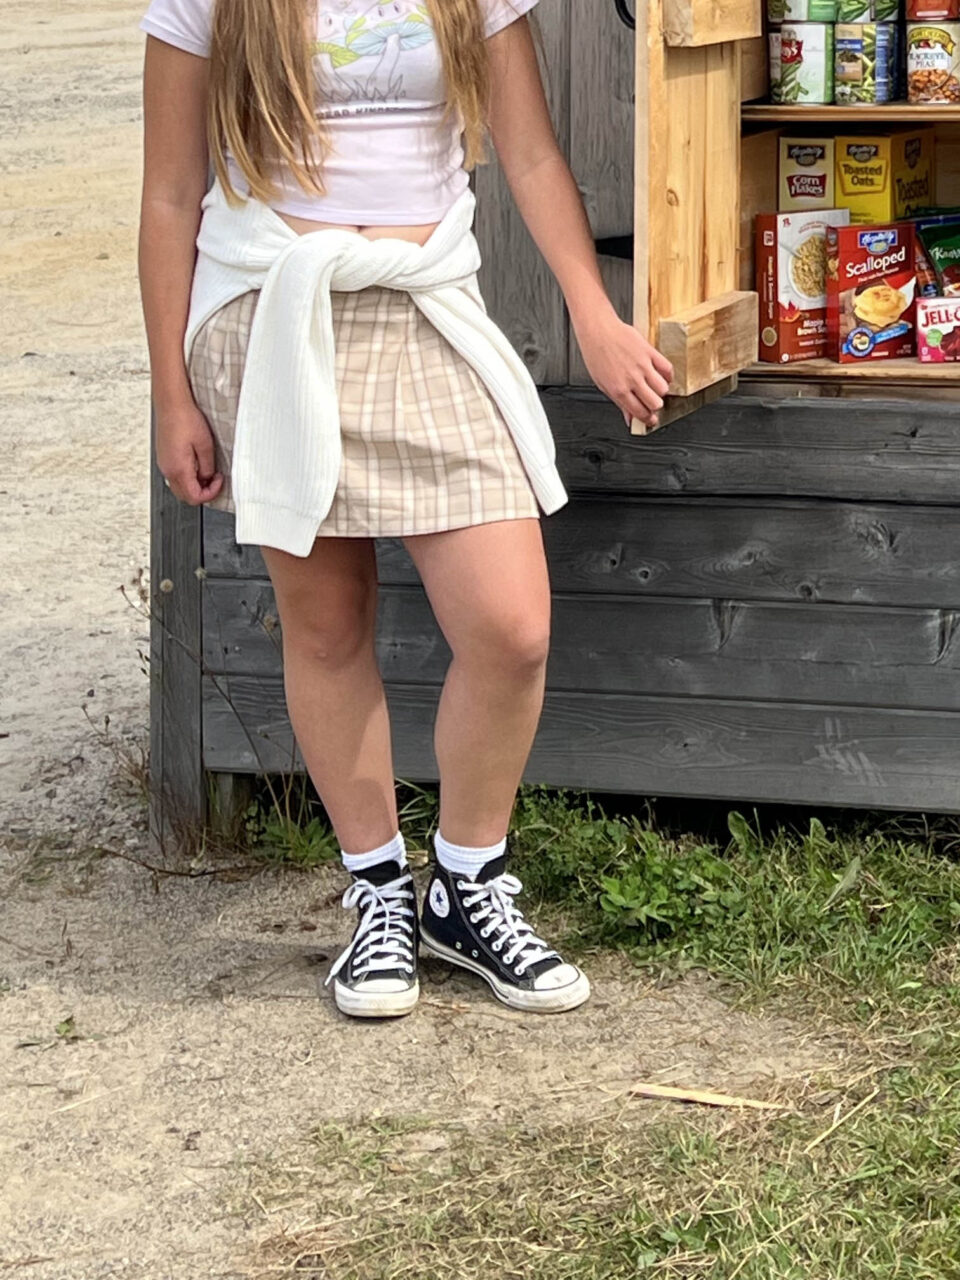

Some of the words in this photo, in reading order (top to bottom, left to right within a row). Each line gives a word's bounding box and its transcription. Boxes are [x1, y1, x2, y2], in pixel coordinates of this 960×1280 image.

[842, 164, 882, 176] Toasted
[851, 175, 875, 186] Oats
[846, 246, 906, 278] Scalloped
